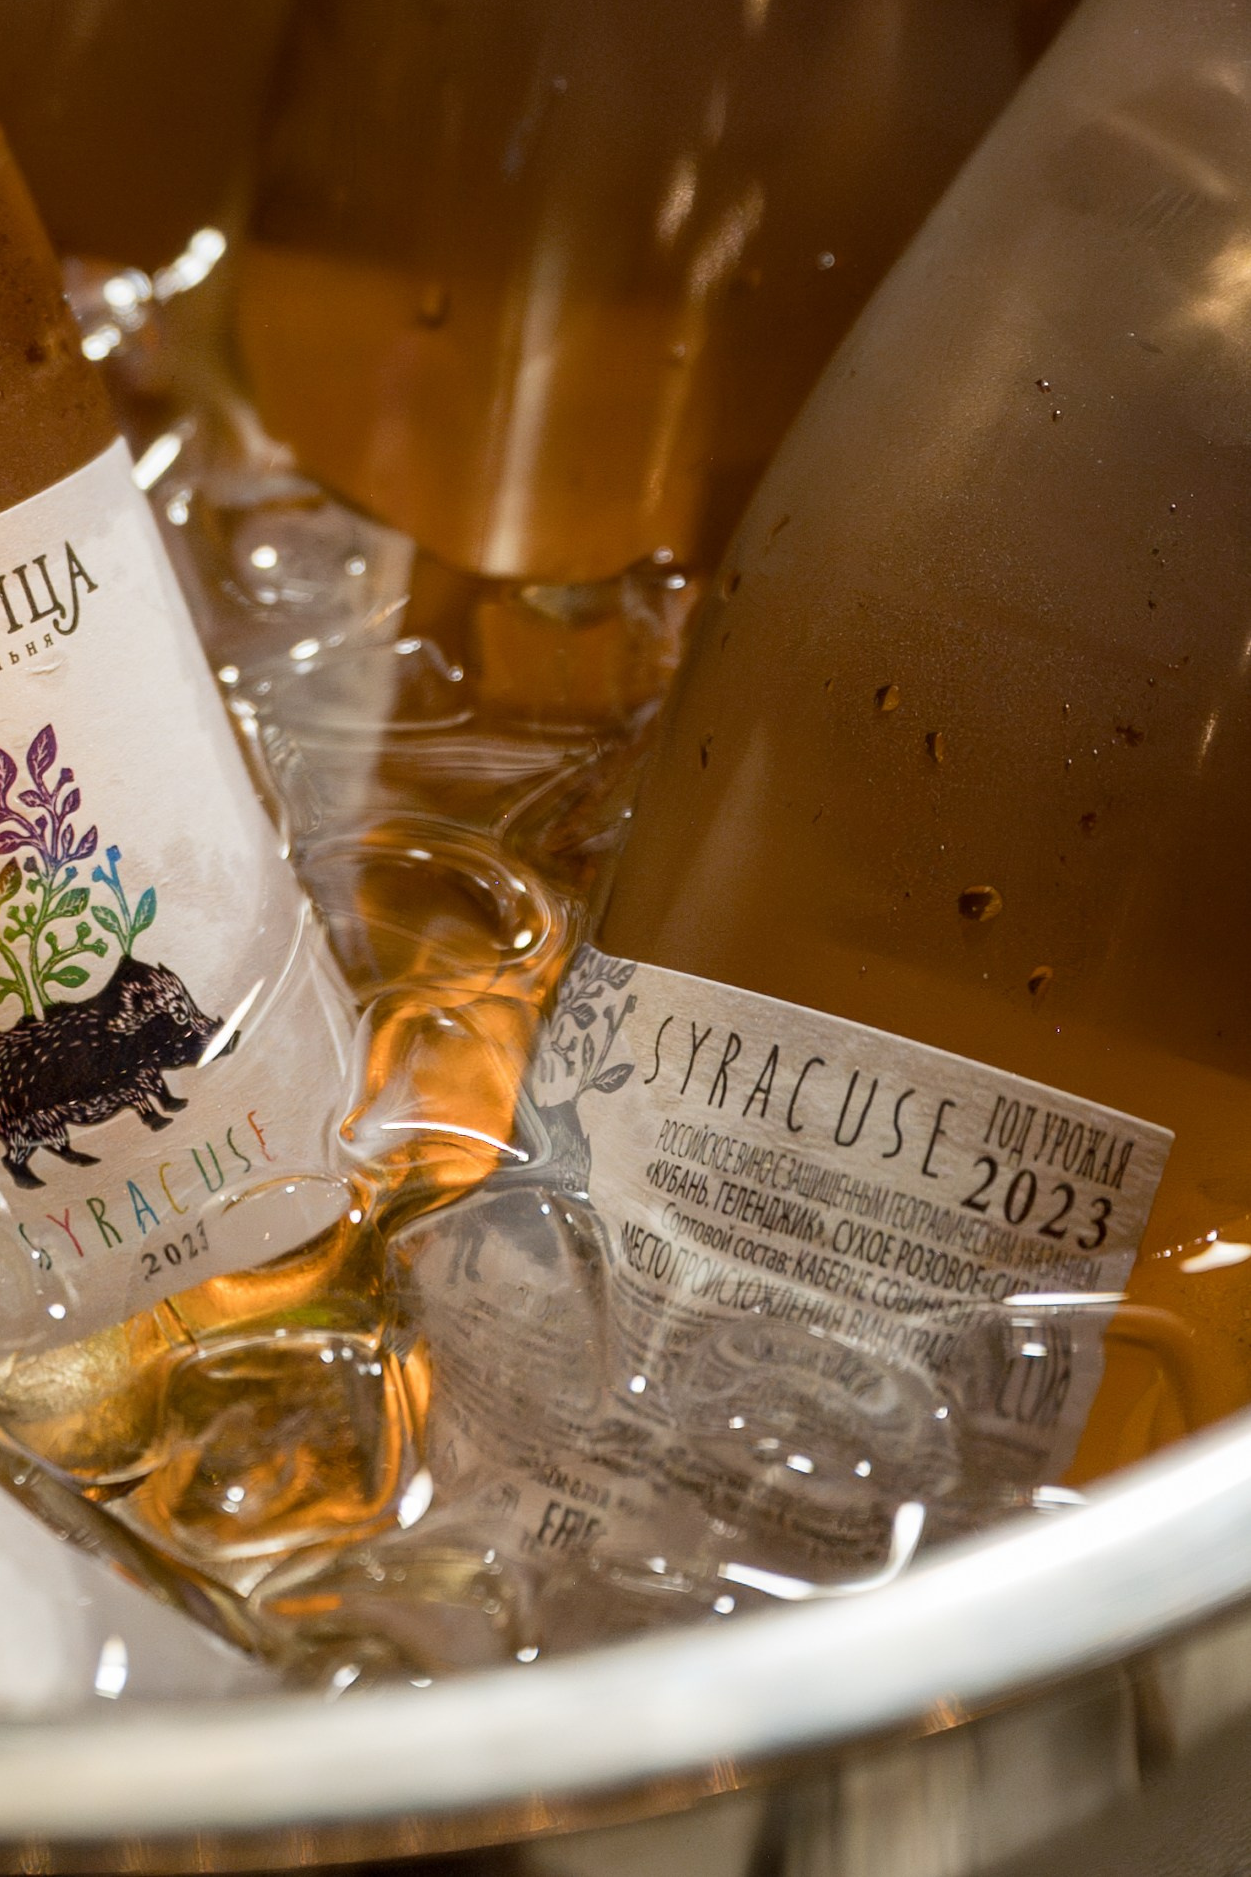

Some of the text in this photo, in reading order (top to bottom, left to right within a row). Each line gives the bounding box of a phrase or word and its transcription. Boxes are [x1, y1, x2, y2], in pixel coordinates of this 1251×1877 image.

[643, 1015, 956, 1179] SYRACUSE
[983, 1095, 1134, 1189] ГОД УРОЖАЯ
[655, 1119, 738, 1172] РОССИЙСКОЕ
[732, 1142, 774, 1187] ВИНО
[960, 1155, 1112, 1250] 2023
[621, 1220, 672, 1280] МЕСТО
[667, 1245, 848, 1330] ПРОИСХОЖДЕНИЯ
[661, 1202, 734, 1254] Сортовой
[732, 1236, 793, 1277] состав:
[790, 1249, 874, 1301] КАБЕРНЕ
[832, 1218, 897, 1269] СУХОЕ
[893, 1238, 986, 1296] РОЗОВОЕ
